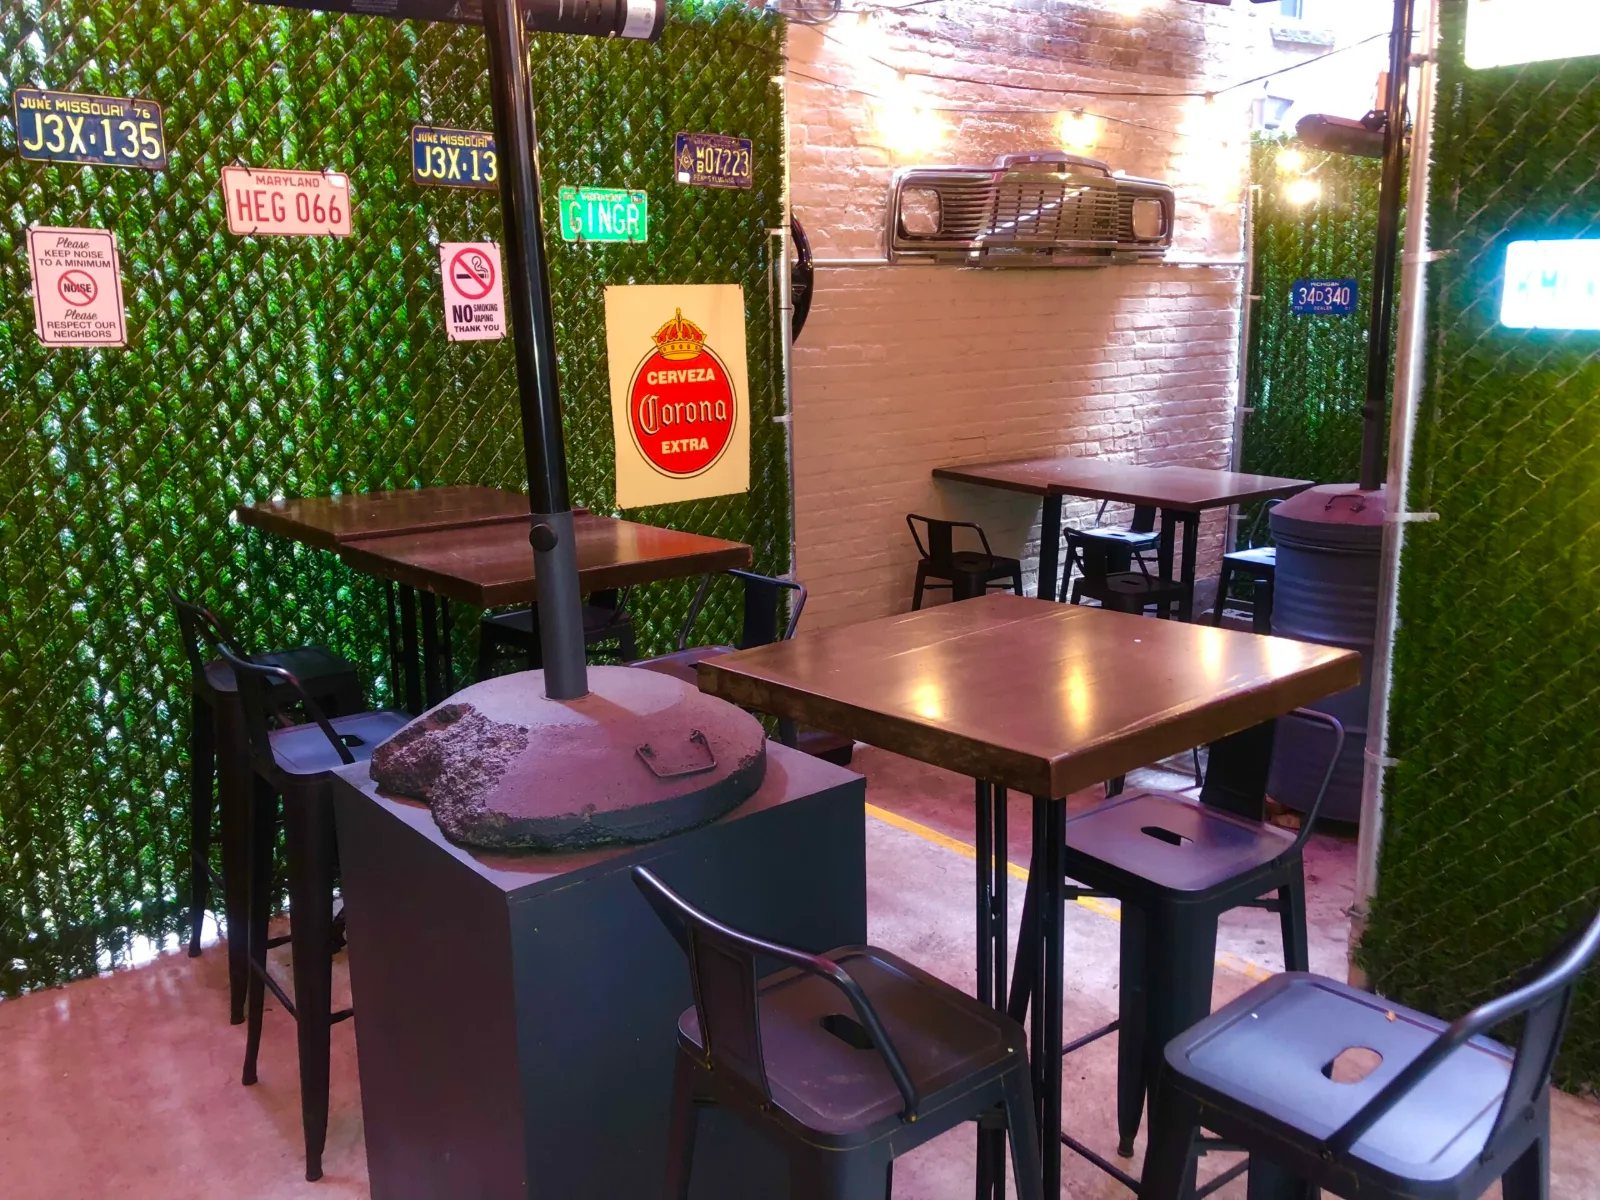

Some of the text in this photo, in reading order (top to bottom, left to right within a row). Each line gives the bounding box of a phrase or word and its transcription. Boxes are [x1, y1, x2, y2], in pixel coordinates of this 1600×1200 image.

[20, 97, 51, 110] JUNE
[56, 101, 124, 117] MISSOURI
[416, 133, 438, 144] JUNE
[440, 134, 488, 148] MISSOURI
[256, 175, 320, 188] MARYLAND
[236, 189, 341, 224] HEG 066
[569, 201, 639, 235] GINGR
[56, 237, 89, 249] Please
[44, 249, 104, 259] KEEP NOISE
[38, 258, 111, 268] TO A MINIMUM
[63, 283, 92, 293] NOISE
[64, 309, 98, 320] Please
[452, 303, 498, 323] NO SMOKING
[474, 313, 493, 322] VAPING
[47, 321, 116, 329] RESPECT OUR
[454, 325, 481, 333] THANK
[53, 330, 112, 338] NEIGHBORS
[647, 368, 715, 385] CERVEZA
[638, 394, 727, 435] Corona
[661, 437, 709, 455] EXTRA
